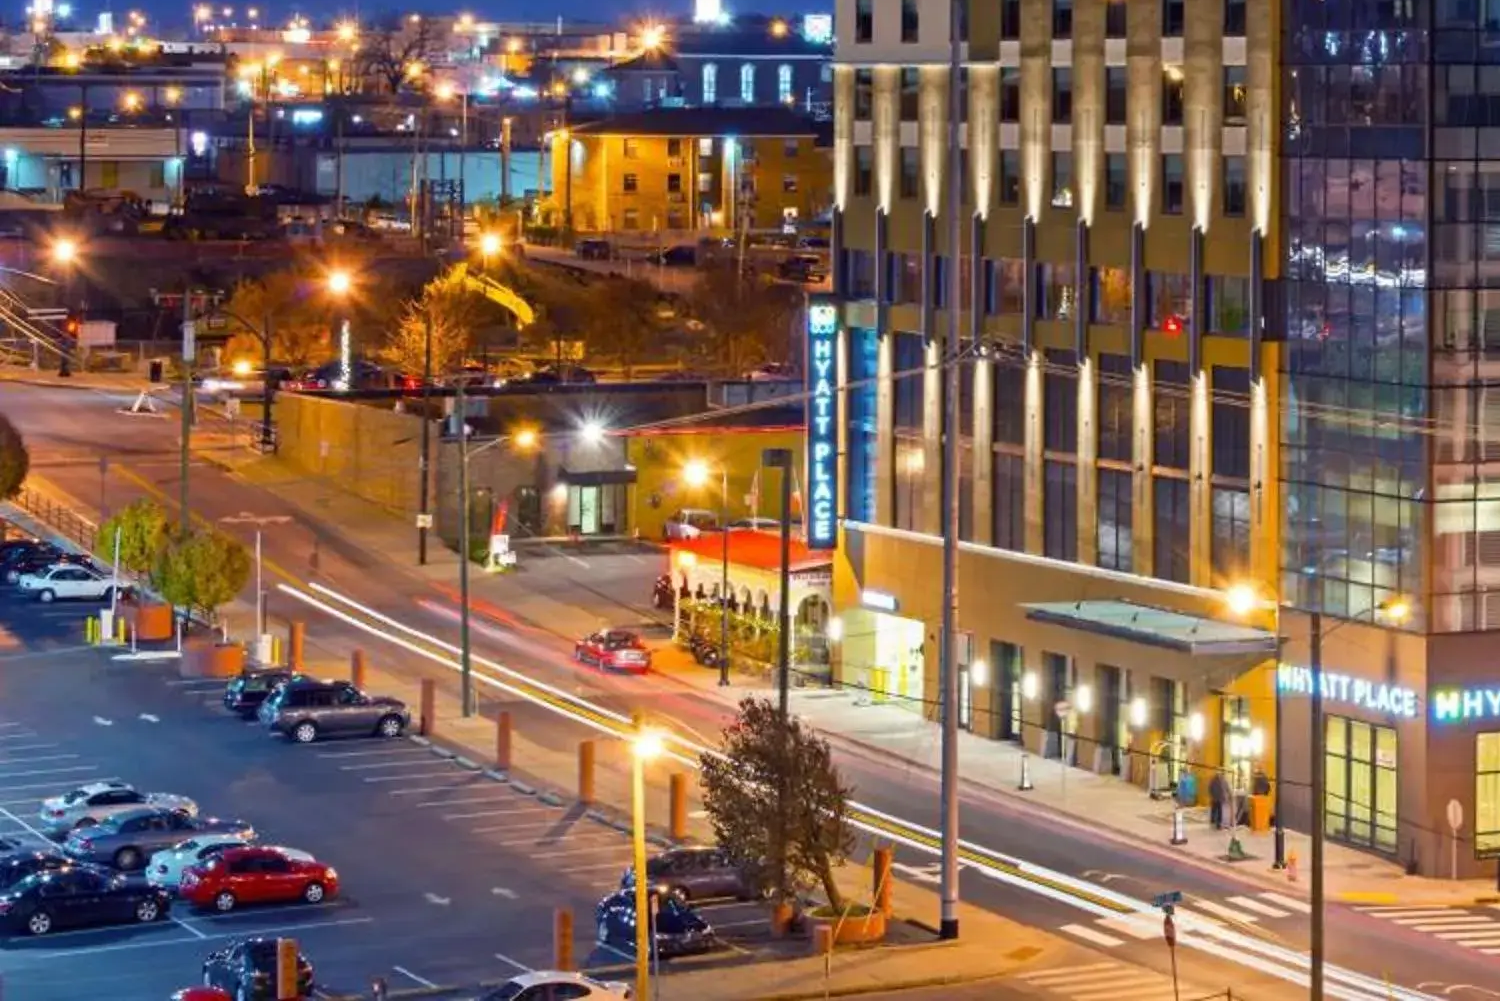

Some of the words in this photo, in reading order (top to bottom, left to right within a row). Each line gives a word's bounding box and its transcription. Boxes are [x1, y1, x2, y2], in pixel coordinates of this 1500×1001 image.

[815, 339, 832, 435] HYATT
[814, 442, 832, 540] PLACE
[1353, 678, 1416, 717] PLACE
